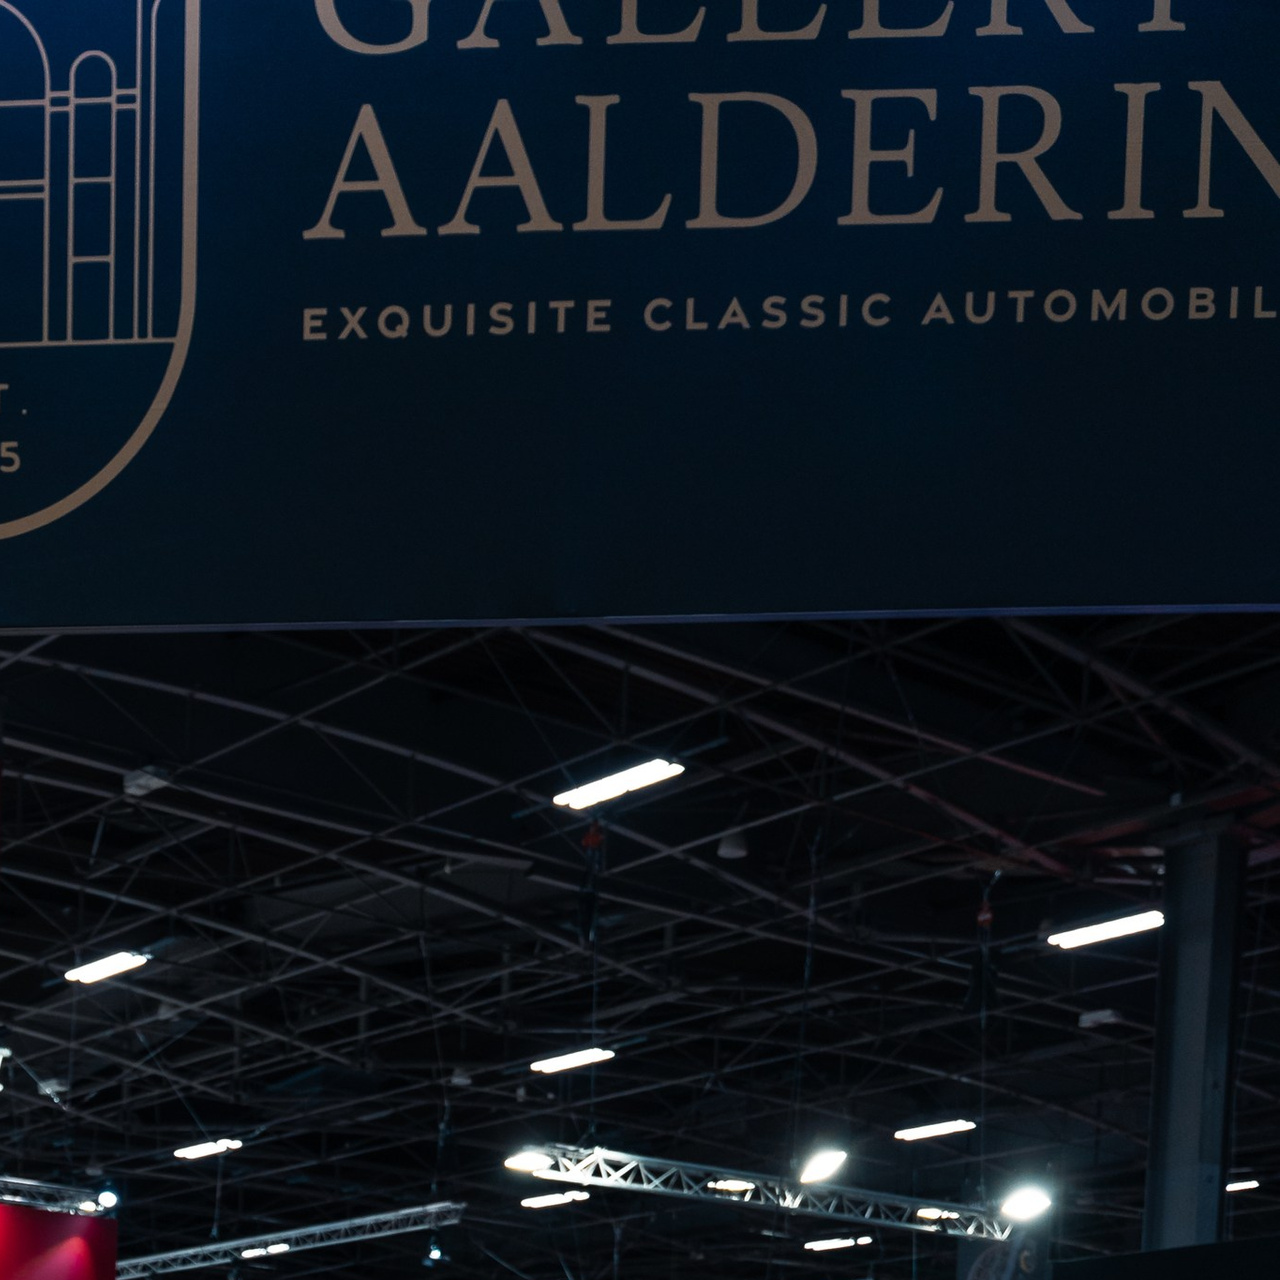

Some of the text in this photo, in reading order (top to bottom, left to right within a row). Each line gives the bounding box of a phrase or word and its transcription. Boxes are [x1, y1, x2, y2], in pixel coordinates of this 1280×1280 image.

[302, 285, 1278, 342] EXQUISITE CLASSIC AUTOMOBIL
